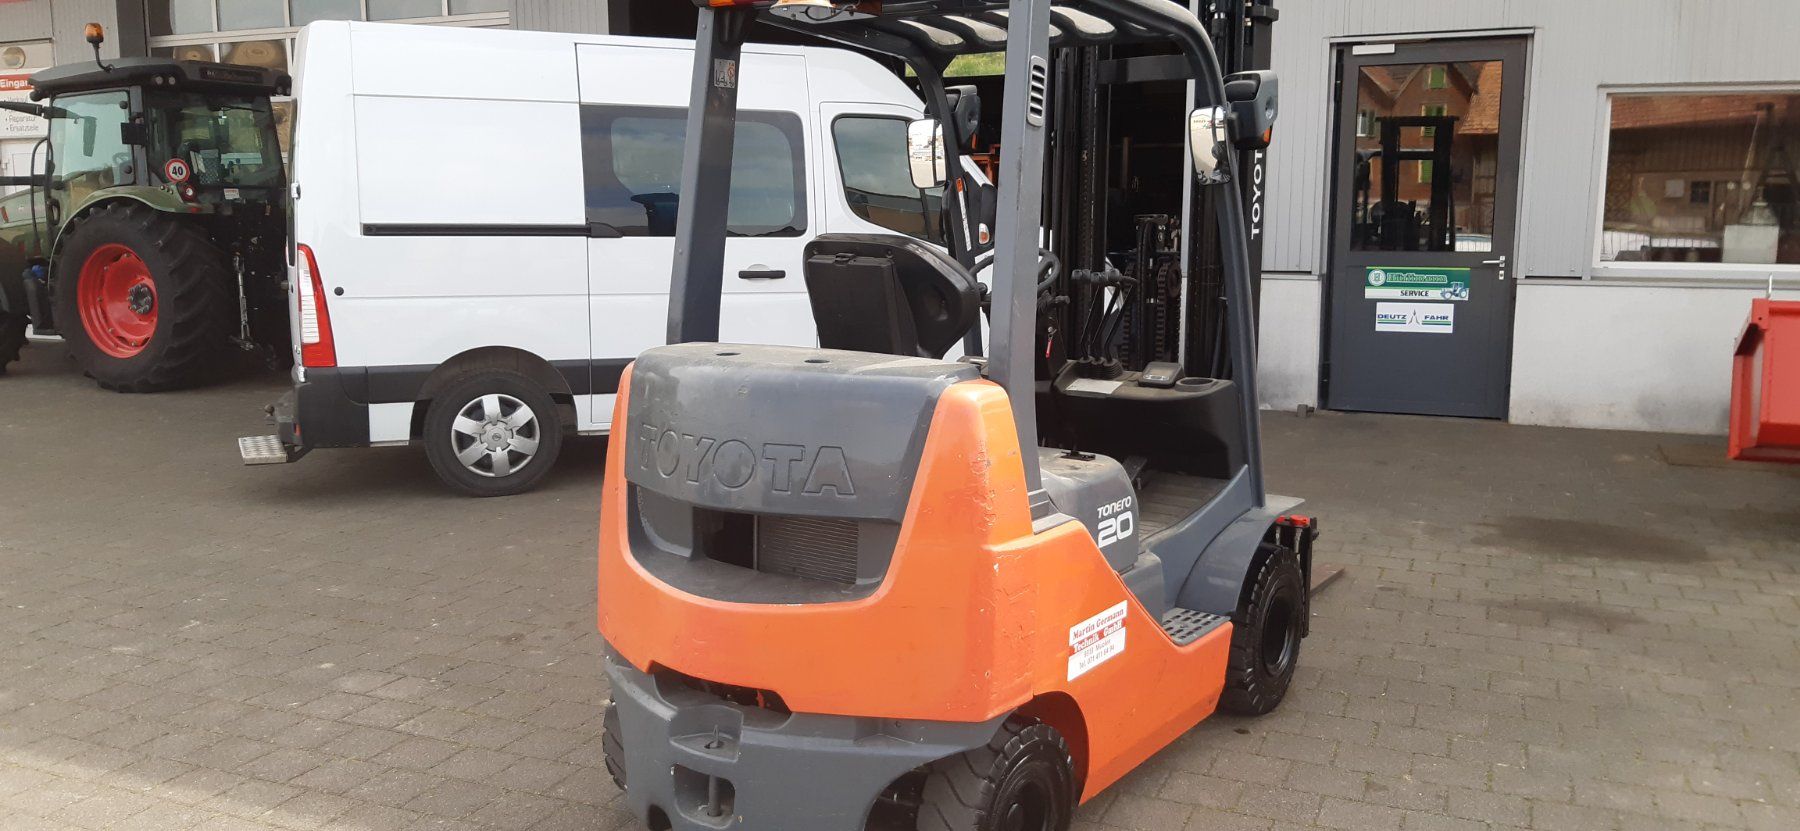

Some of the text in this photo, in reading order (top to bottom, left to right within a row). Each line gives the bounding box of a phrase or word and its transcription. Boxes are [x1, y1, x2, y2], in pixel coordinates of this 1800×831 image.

[0, 79, 34, 89] Einga
[172, 166, 184, 176] 40
[1250, 149, 1263, 240] TOYOT
[640, 422, 857, 498] TOYOTA
[1097, 510, 1133, 548] 20
[1073, 608, 1124, 640] Martin Germann
[1074, 619, 1122, 652] Technik GmbH
